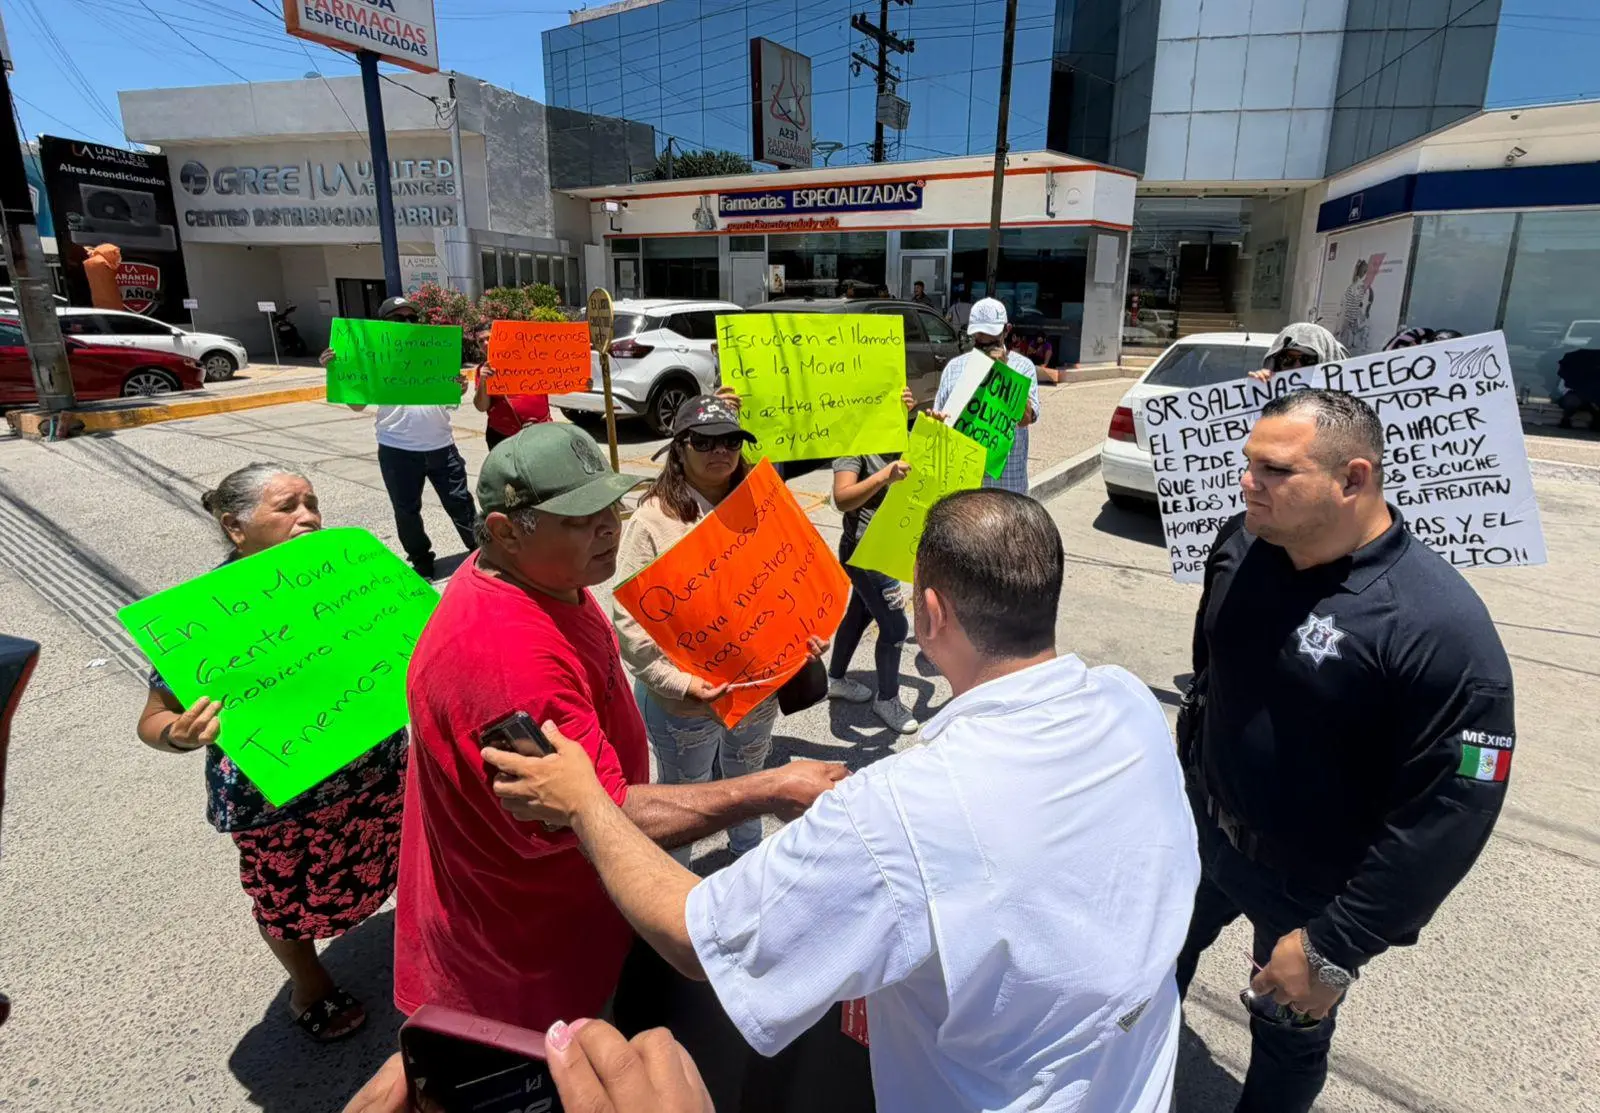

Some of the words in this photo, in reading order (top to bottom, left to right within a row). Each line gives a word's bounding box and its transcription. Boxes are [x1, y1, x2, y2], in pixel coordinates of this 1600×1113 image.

[304, 6, 429, 57] ESPECIALIZADAS
[59, 163, 87, 174] Aires
[89, 167, 166, 186] Acondicionados
[213, 164, 300, 196] GREE
[356, 159, 455, 179] UITED
[720, 194, 786, 212] Farmacias
[792, 183, 918, 209] ESPECIALIZADAS
[115, 271, 156, 282] ARANTÍA
[528, 345, 549, 361] de
[827, 325, 843, 347] el
[731, 353, 758, 380] de
[773, 354, 790, 376] la
[800, 355, 846, 376] Mora
[1145, 395, 1187, 427] SR.
[1187, 371, 1314, 423] SALINAS
[1320, 355, 1437, 397] PLIEGO
[775, 423, 830, 451] ayuda
[1149, 433, 1174, 456] EL
[1179, 418, 1252, 453] PUEBL
[1375, 382, 1468, 415] MORA
[1153, 456, 1178, 473] LE
[1183, 450, 1237, 473] PIDE
[1405, 407, 1487, 441] HACER
[1157, 477, 1196, 498] QUE
[1201, 468, 1245, 491] NUE
[1382, 443, 1427, 467] EGE
[1431, 433, 1487, 458] MUY
[1161, 494, 1223, 515] LEJOS
[1412, 453, 1501, 480] ESCUCHE
[1166, 515, 1230, 539] HOMBRE
[1396, 477, 1511, 507] ENFRENTAN
[1170, 545, 1182, 559] A
[1187, 544, 1212, 558] BA
[1455, 513, 1473, 533] Y
[1483, 511, 1524, 529] EL
[639, 526, 757, 623] Queremos
[733, 540, 794, 609] nuestros
[1173, 560, 1206, 574] PUE
[138, 616, 209, 657] En
[262, 560, 337, 601] Mora
[692, 607, 775, 674] hogares
[777, 588, 796, 615] y
[195, 623, 295, 685] Gente
[239, 659, 393, 768] Tenemos
[1462, 729, 1513, 748] MÉXICO
